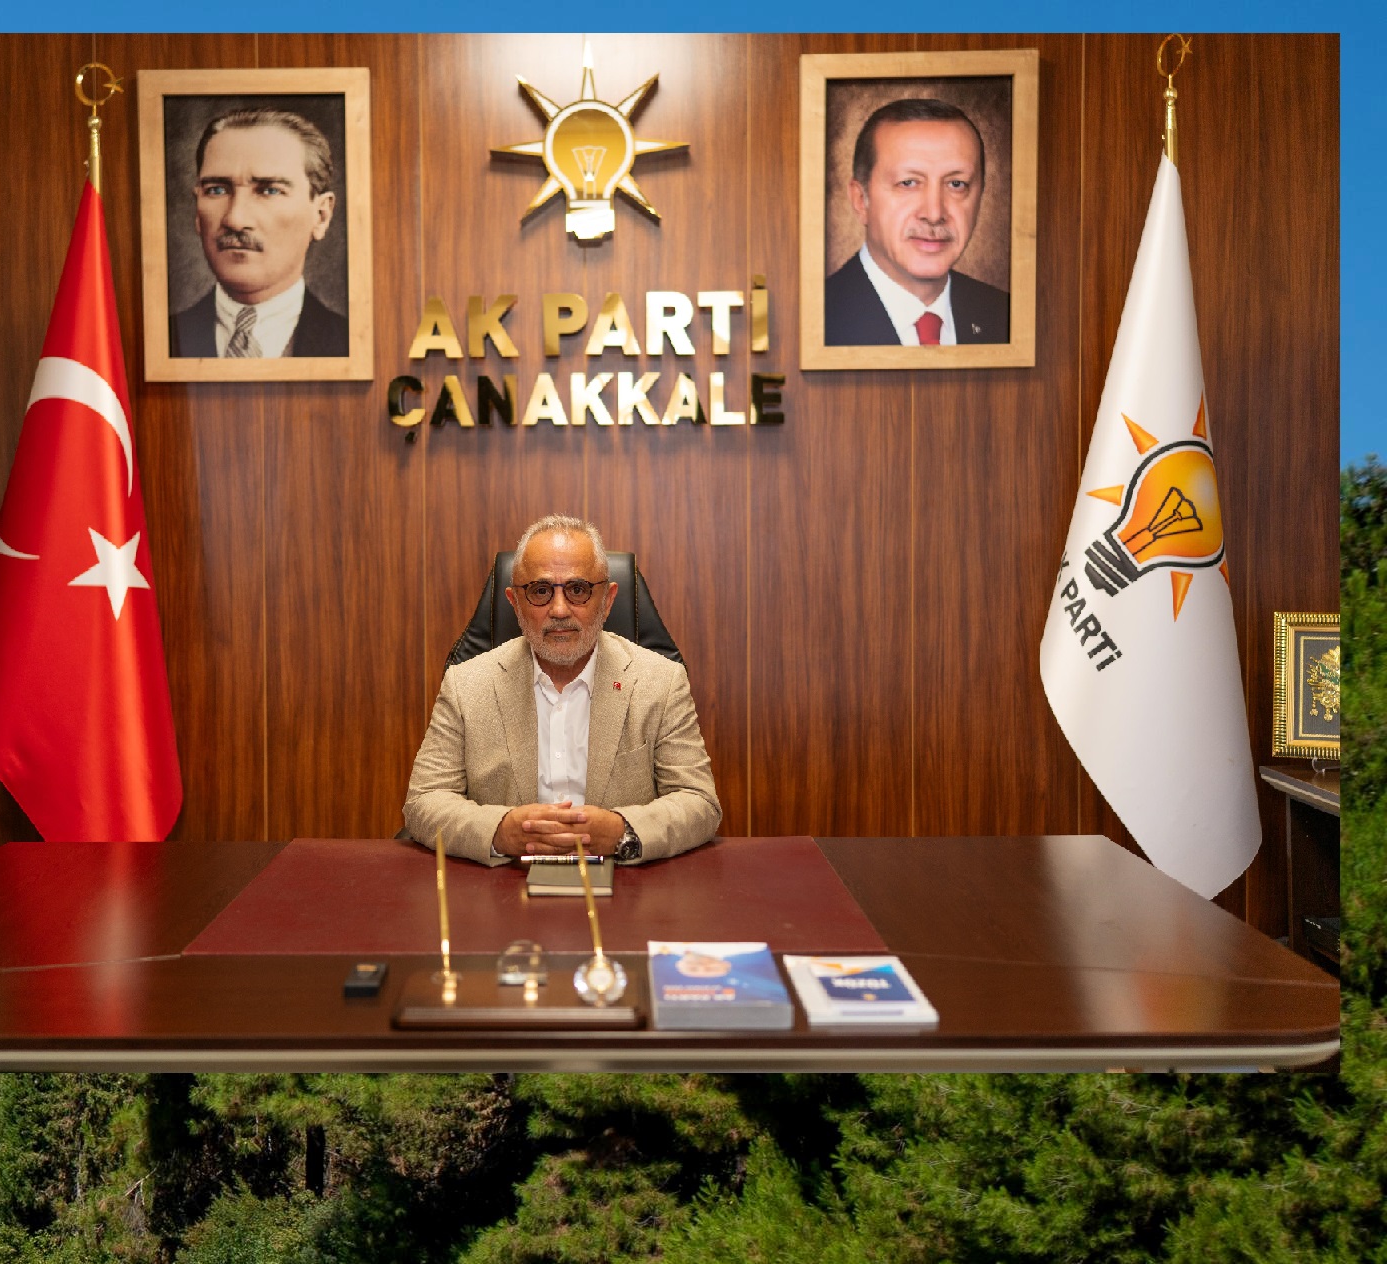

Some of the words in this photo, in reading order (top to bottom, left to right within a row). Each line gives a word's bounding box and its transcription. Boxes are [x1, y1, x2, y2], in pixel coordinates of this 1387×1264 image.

[408, 293, 519, 358] AK
[542, 274, 769, 356] PARTİ
[387, 372, 786, 443] ÇANAKKALE
